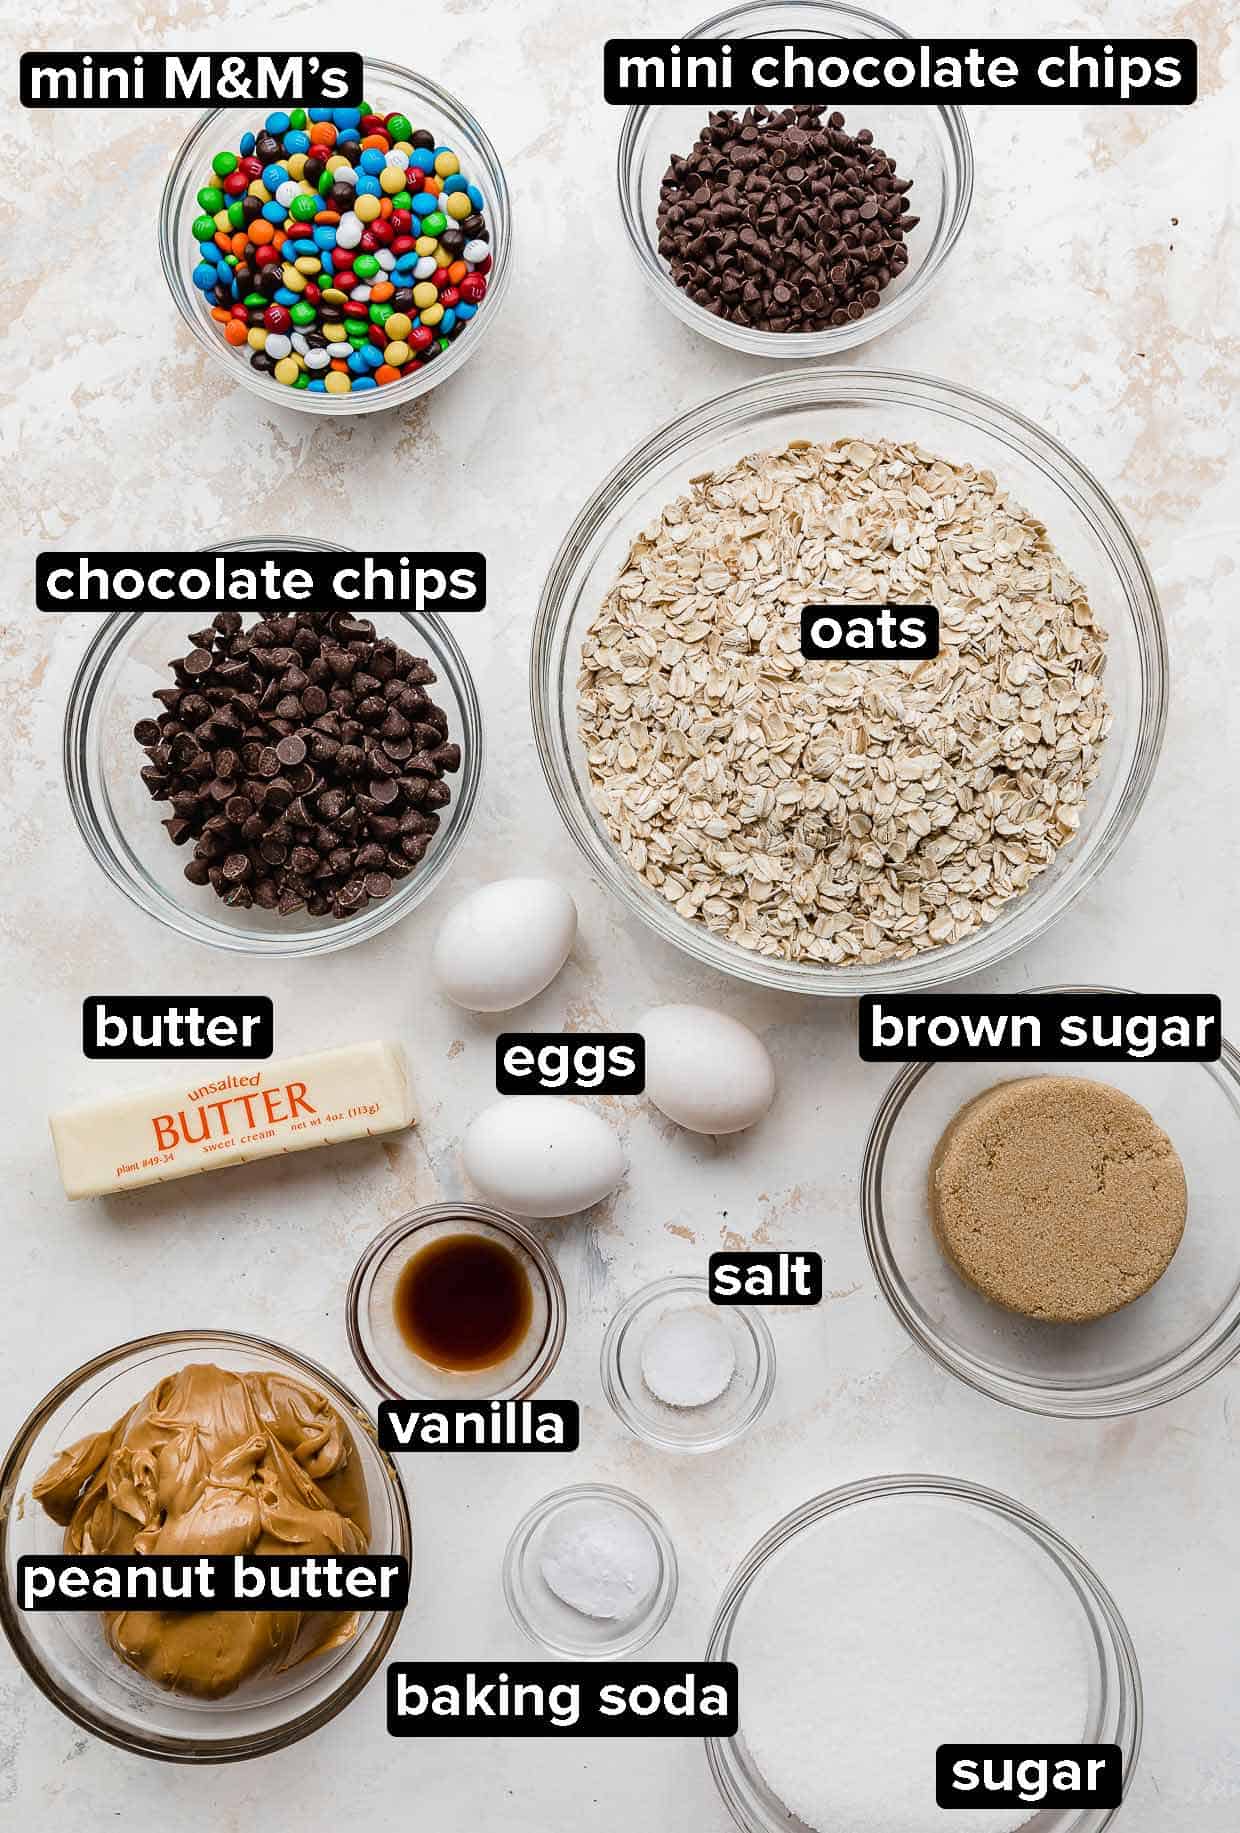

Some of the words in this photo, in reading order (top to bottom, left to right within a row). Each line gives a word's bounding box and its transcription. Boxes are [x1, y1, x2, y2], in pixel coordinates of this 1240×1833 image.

[187, 1072, 261, 1102] unsalted
[152, 1082, 317, 1151] BUTTER
[291, 1121, 307, 1132] net
[326, 1113, 345, 1123] 4oz
[348, 1103, 380, 1118] (113g)
[201, 1137, 236, 1153] sweet
[240, 1129, 275, 1144] cream
[115, 1161, 140, 1177] plant
